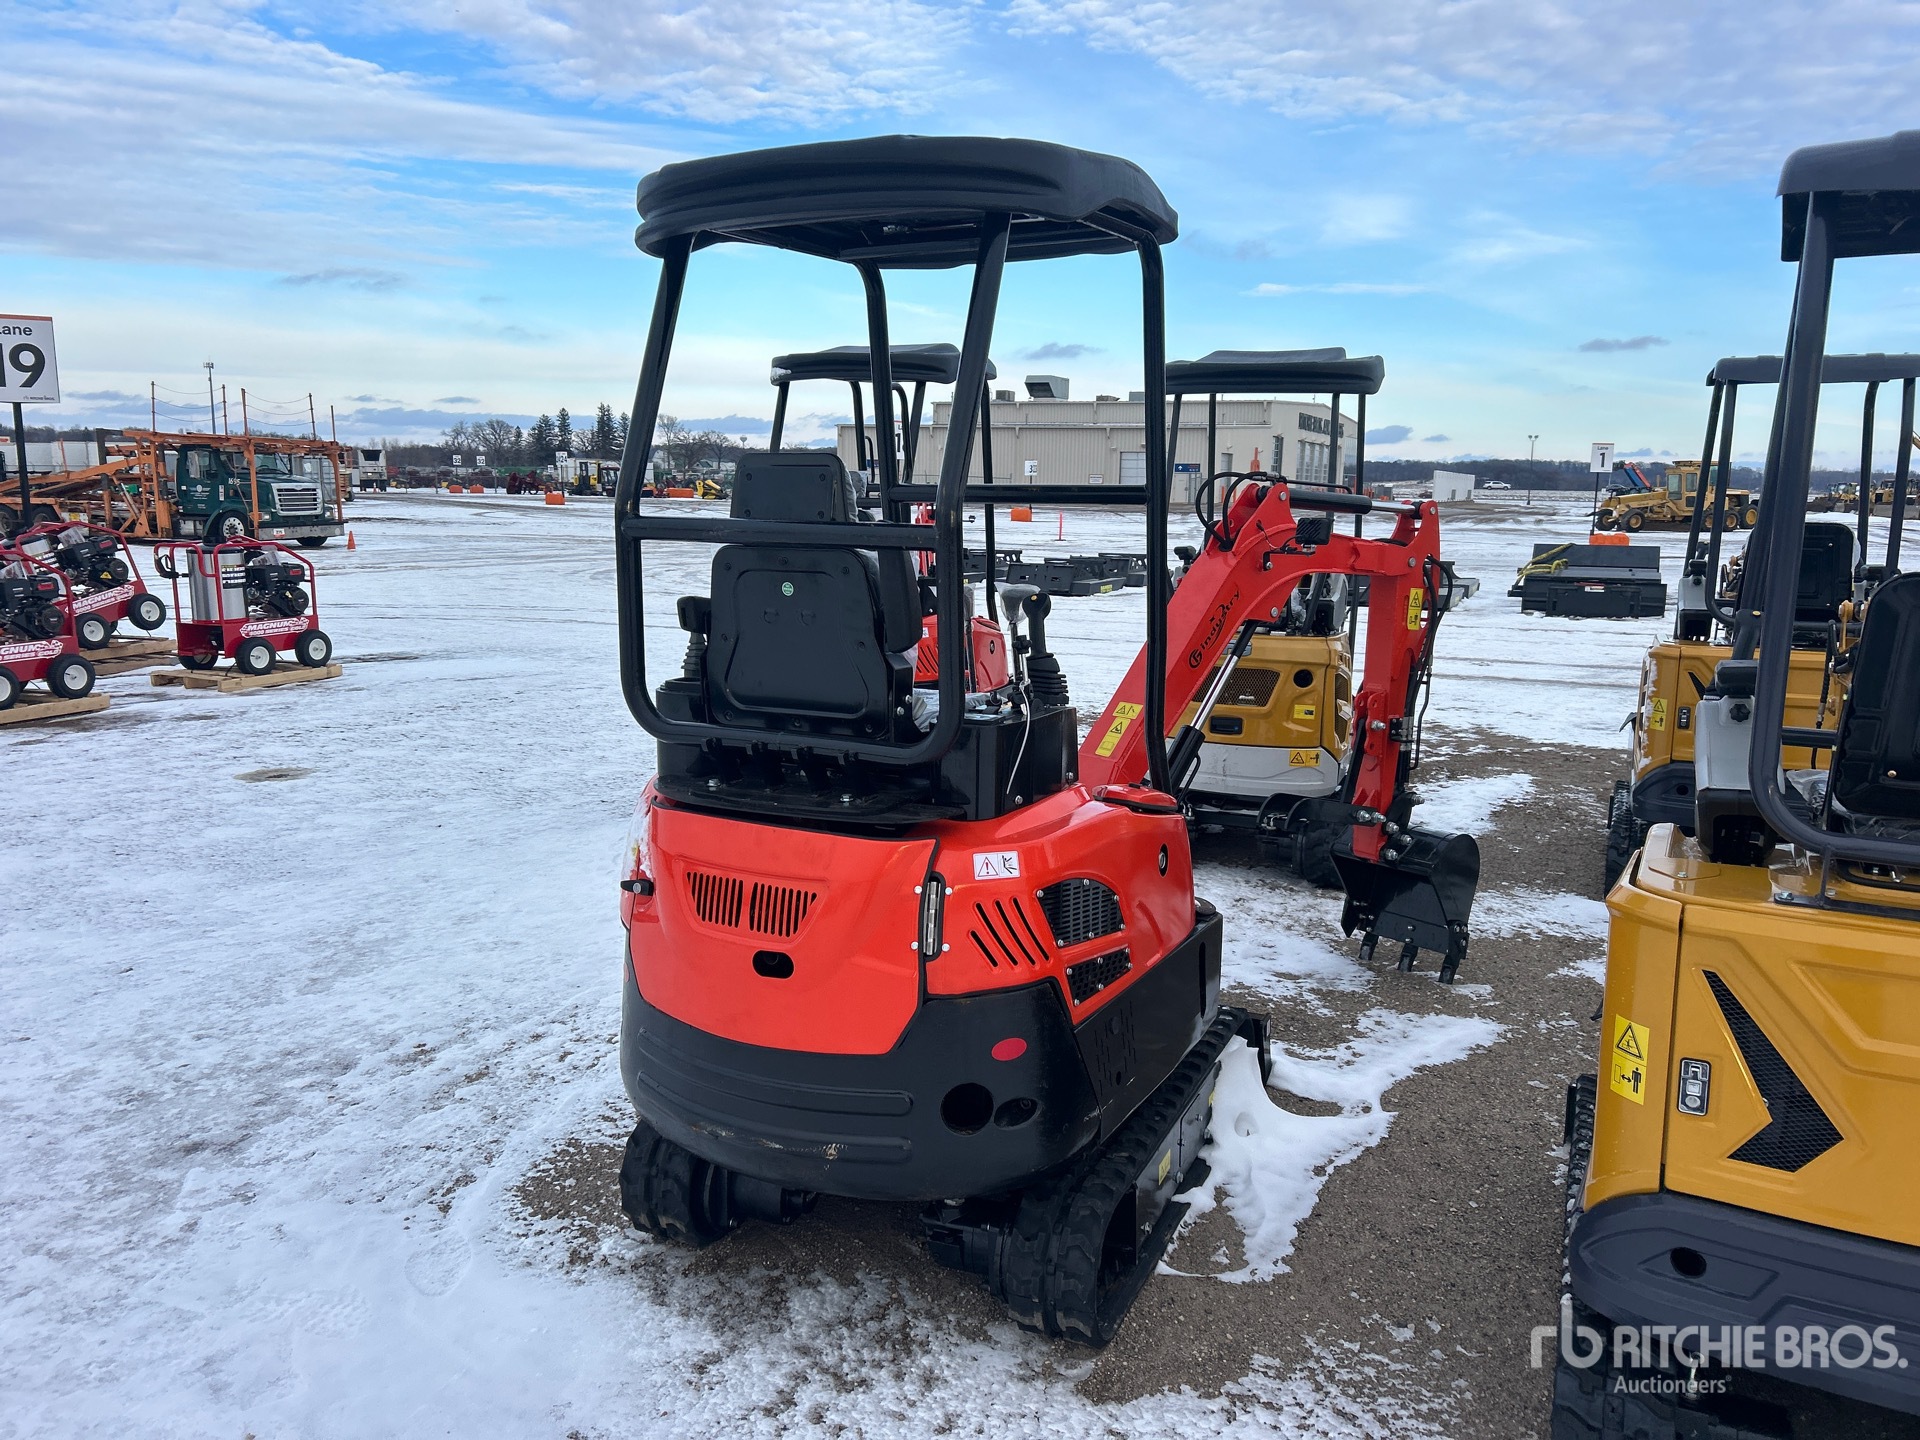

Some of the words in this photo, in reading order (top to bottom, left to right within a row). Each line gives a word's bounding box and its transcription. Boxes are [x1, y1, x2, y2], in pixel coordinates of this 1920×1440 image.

[0, 325, 33, 336] ane
[1599, 452, 1606, 468] 1
[72, 590, 116, 609] MAGNUM
[247, 620, 290, 631] MAGNUM
[0, 644, 36, 655] GNUM
[3, 652, 36, 660] SERIES
